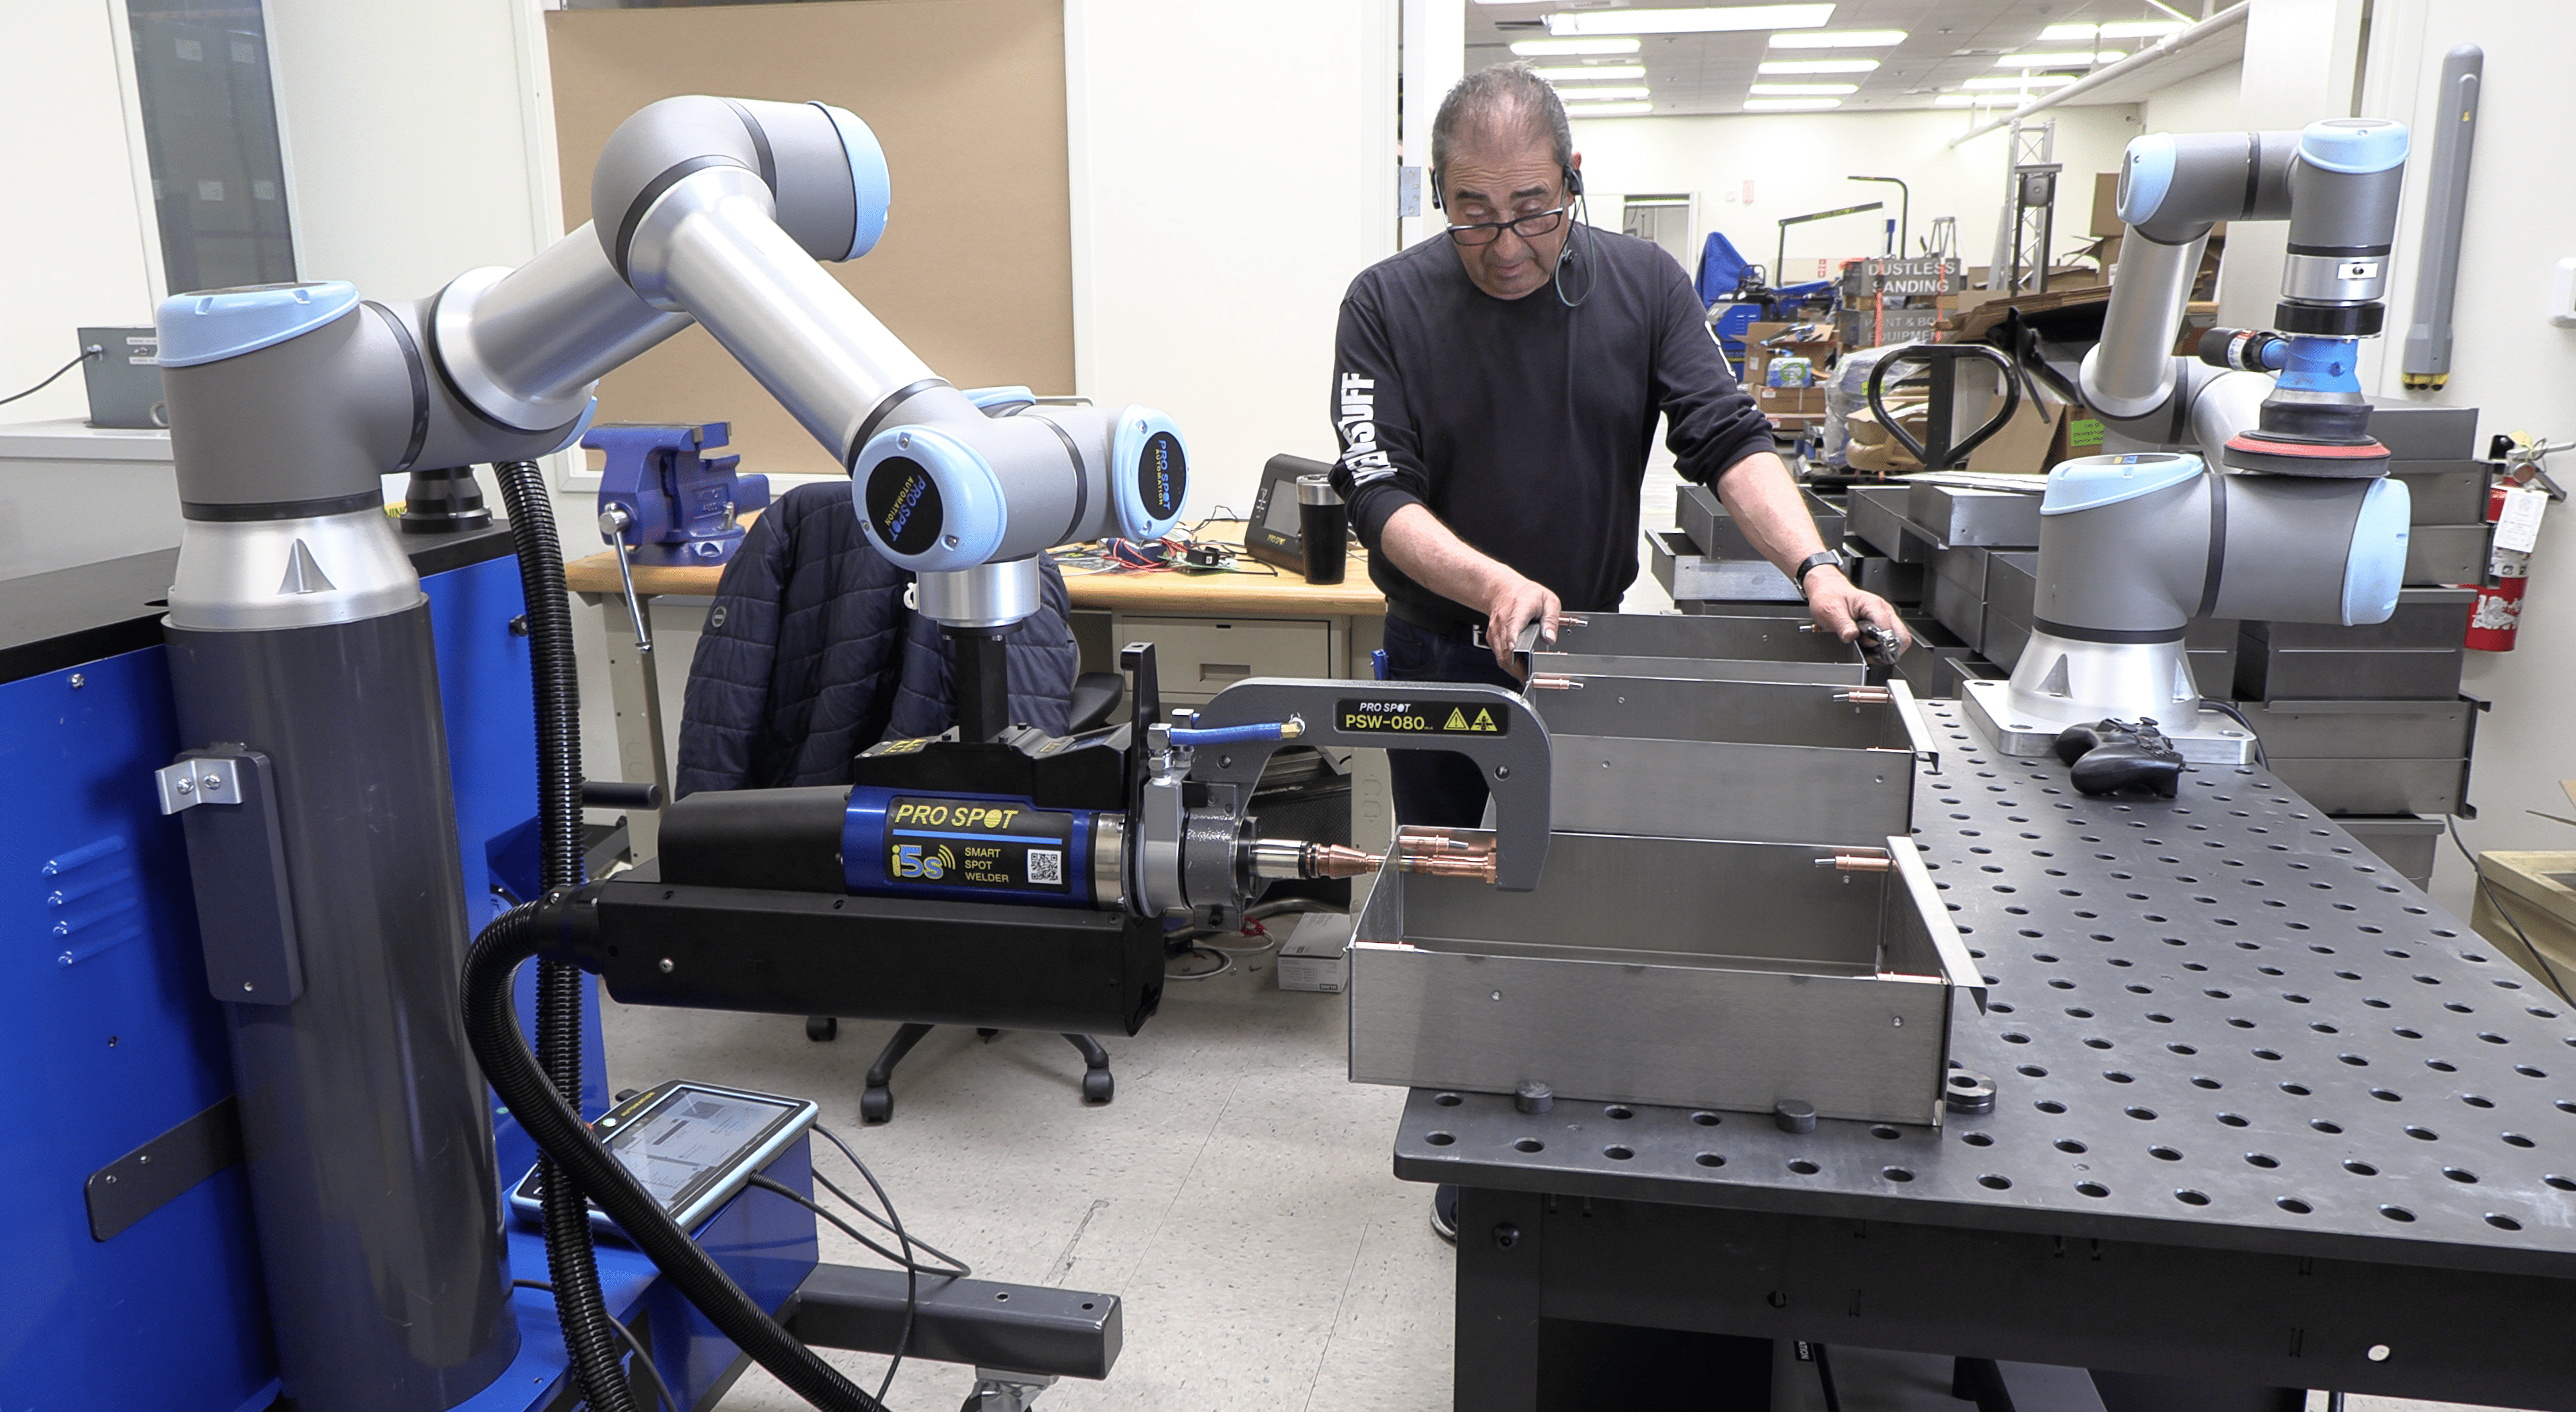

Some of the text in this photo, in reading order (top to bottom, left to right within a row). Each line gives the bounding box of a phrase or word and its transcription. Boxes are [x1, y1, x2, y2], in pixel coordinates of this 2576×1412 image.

[1868, 262, 1956, 276] DUSTLESS
[1865, 317, 1902, 328] PNT
[1905, 317, 1915, 327] &
[1155, 449, 1164, 505] AUTOMATION
[1159, 440, 1171, 510] PRO SPOT
[884, 476, 914, 526] AUTOMATION
[888, 474, 927, 541] PRO SPOT
[1359, 702, 1411, 713] PRO SPOT
[1345, 714, 1425, 730] PSW-080
[894, 804, 1019, 829] PRO SPOT
[964, 847, 1001, 858] SMART
[964, 859, 993, 870] SPOT
[965, 872, 1009, 884] WELDER
